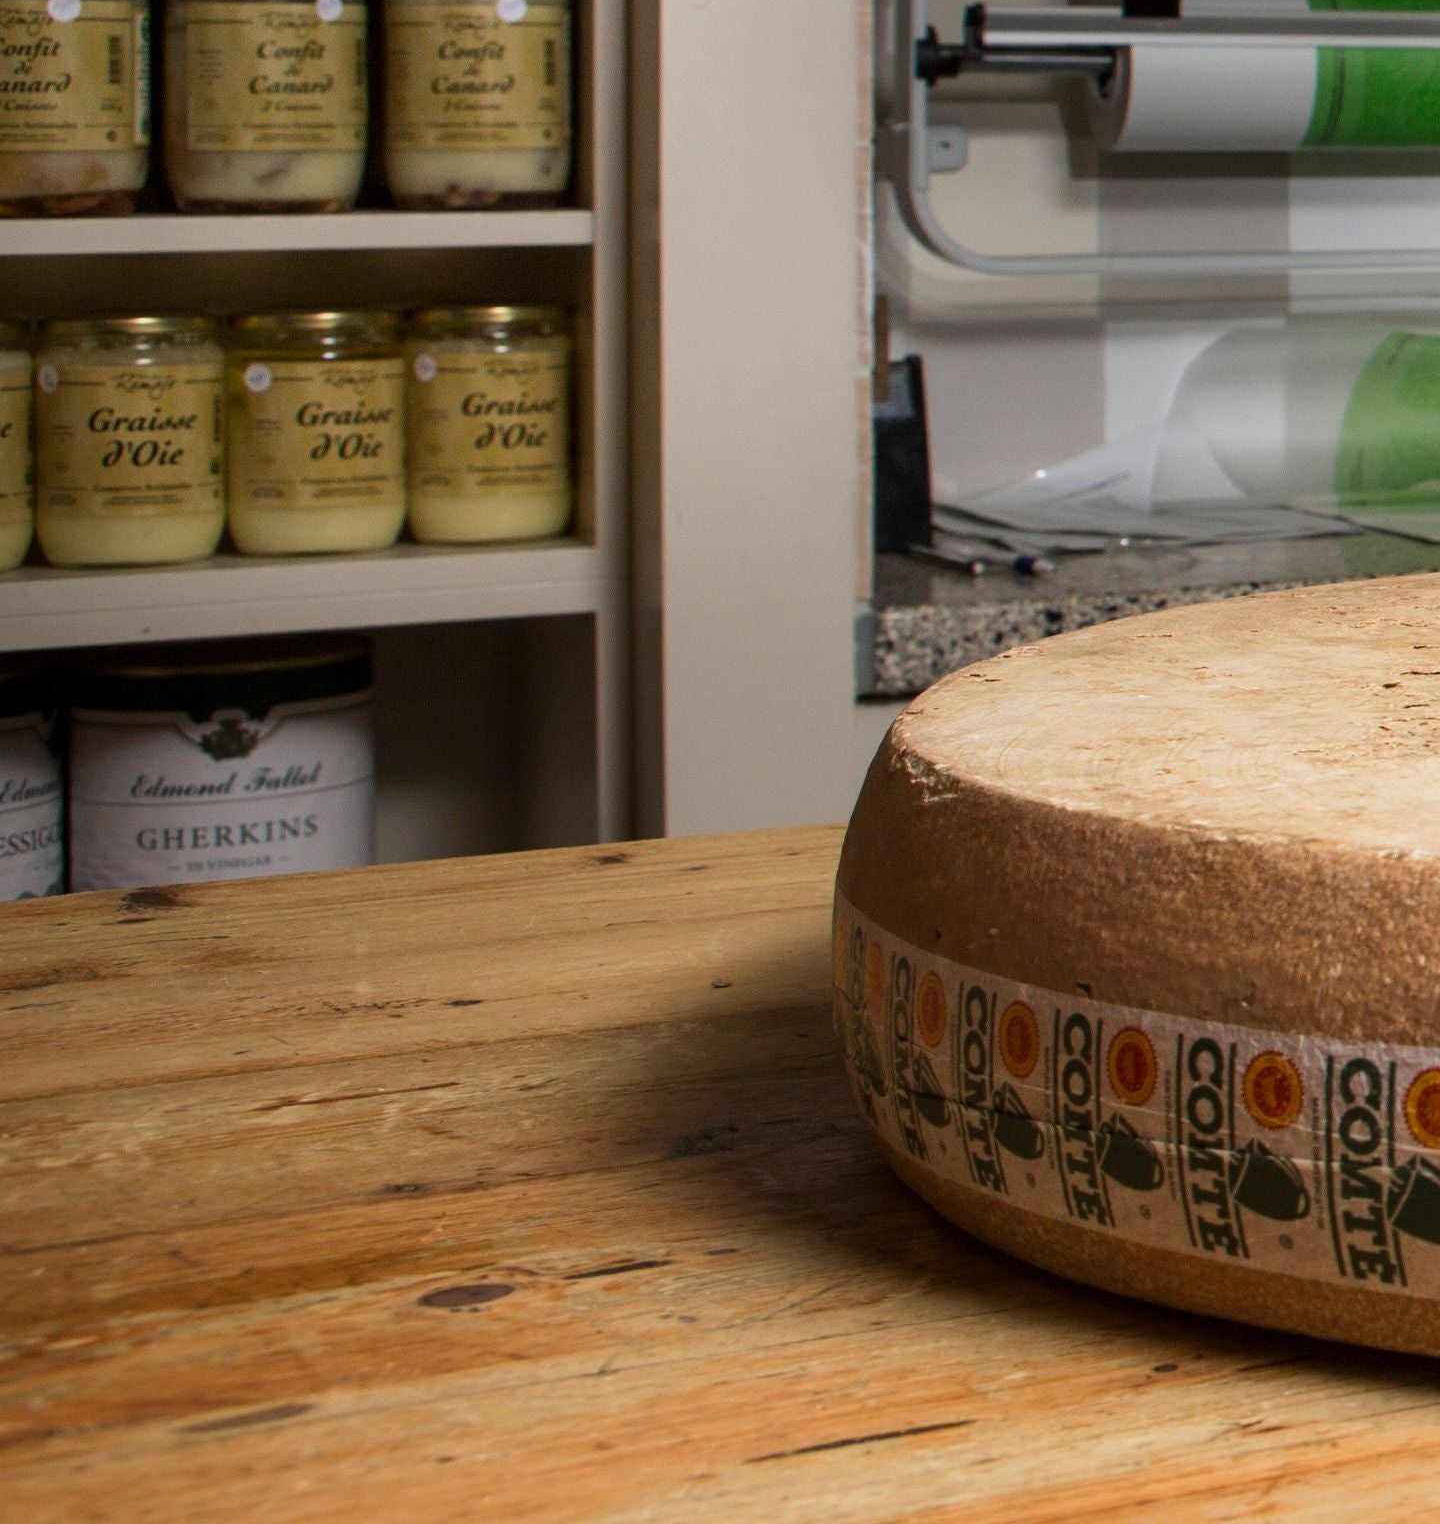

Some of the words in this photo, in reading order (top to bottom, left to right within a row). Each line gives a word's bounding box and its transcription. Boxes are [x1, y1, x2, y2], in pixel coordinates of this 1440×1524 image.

[0, 72, 72, 94] anard
[102, 439, 184, 467] d'Oie
[130, 772, 239, 798] Edmond
[136, 814, 320, 852] GHERKINS
